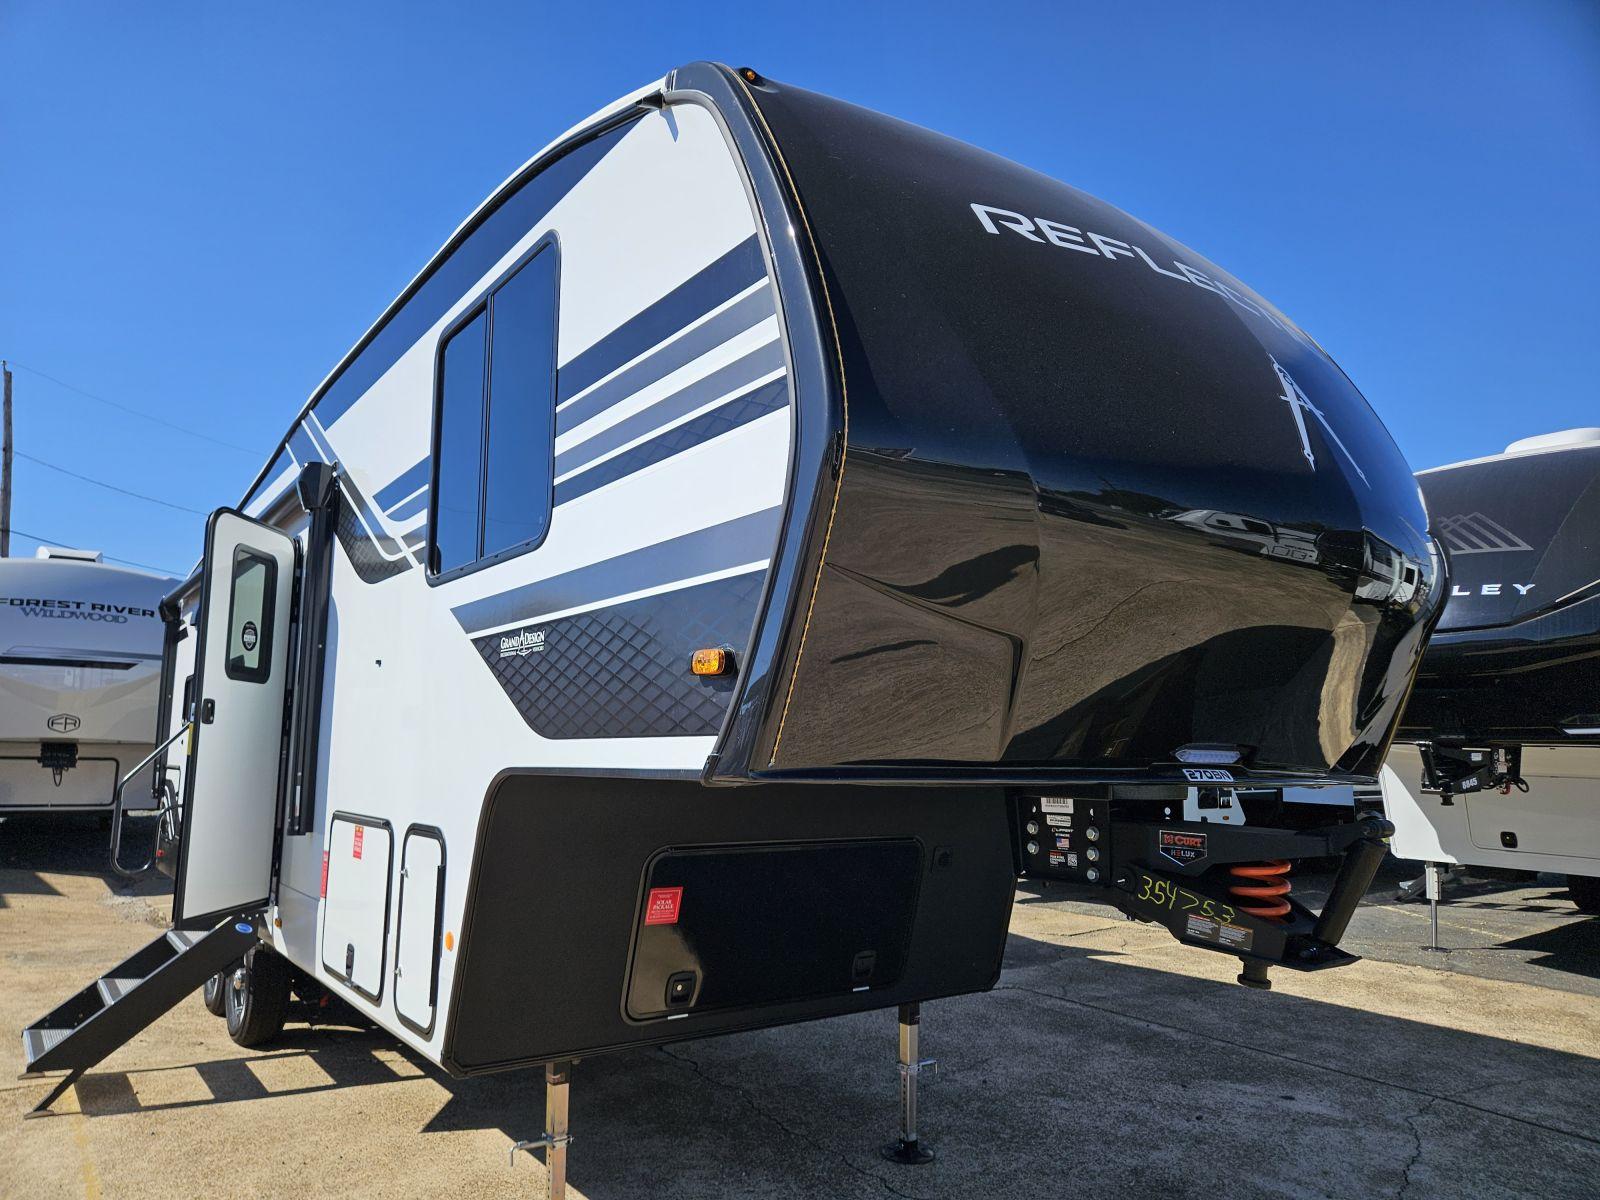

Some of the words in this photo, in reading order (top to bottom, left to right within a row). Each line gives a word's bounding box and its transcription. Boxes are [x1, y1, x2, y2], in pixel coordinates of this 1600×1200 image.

[970, 203, 1318, 352] REFLECT
[20, 607, 128, 624] WILDWOOD
[91, 602, 155, 618] RIVER
[501, 636, 520, 649] GRAND
[524, 630, 545, 645] DESIGN
[1185, 769, 1231, 780] 270BN
[1174, 835, 1202, 847] CURT
[1170, 849, 1196, 858] HELUX
